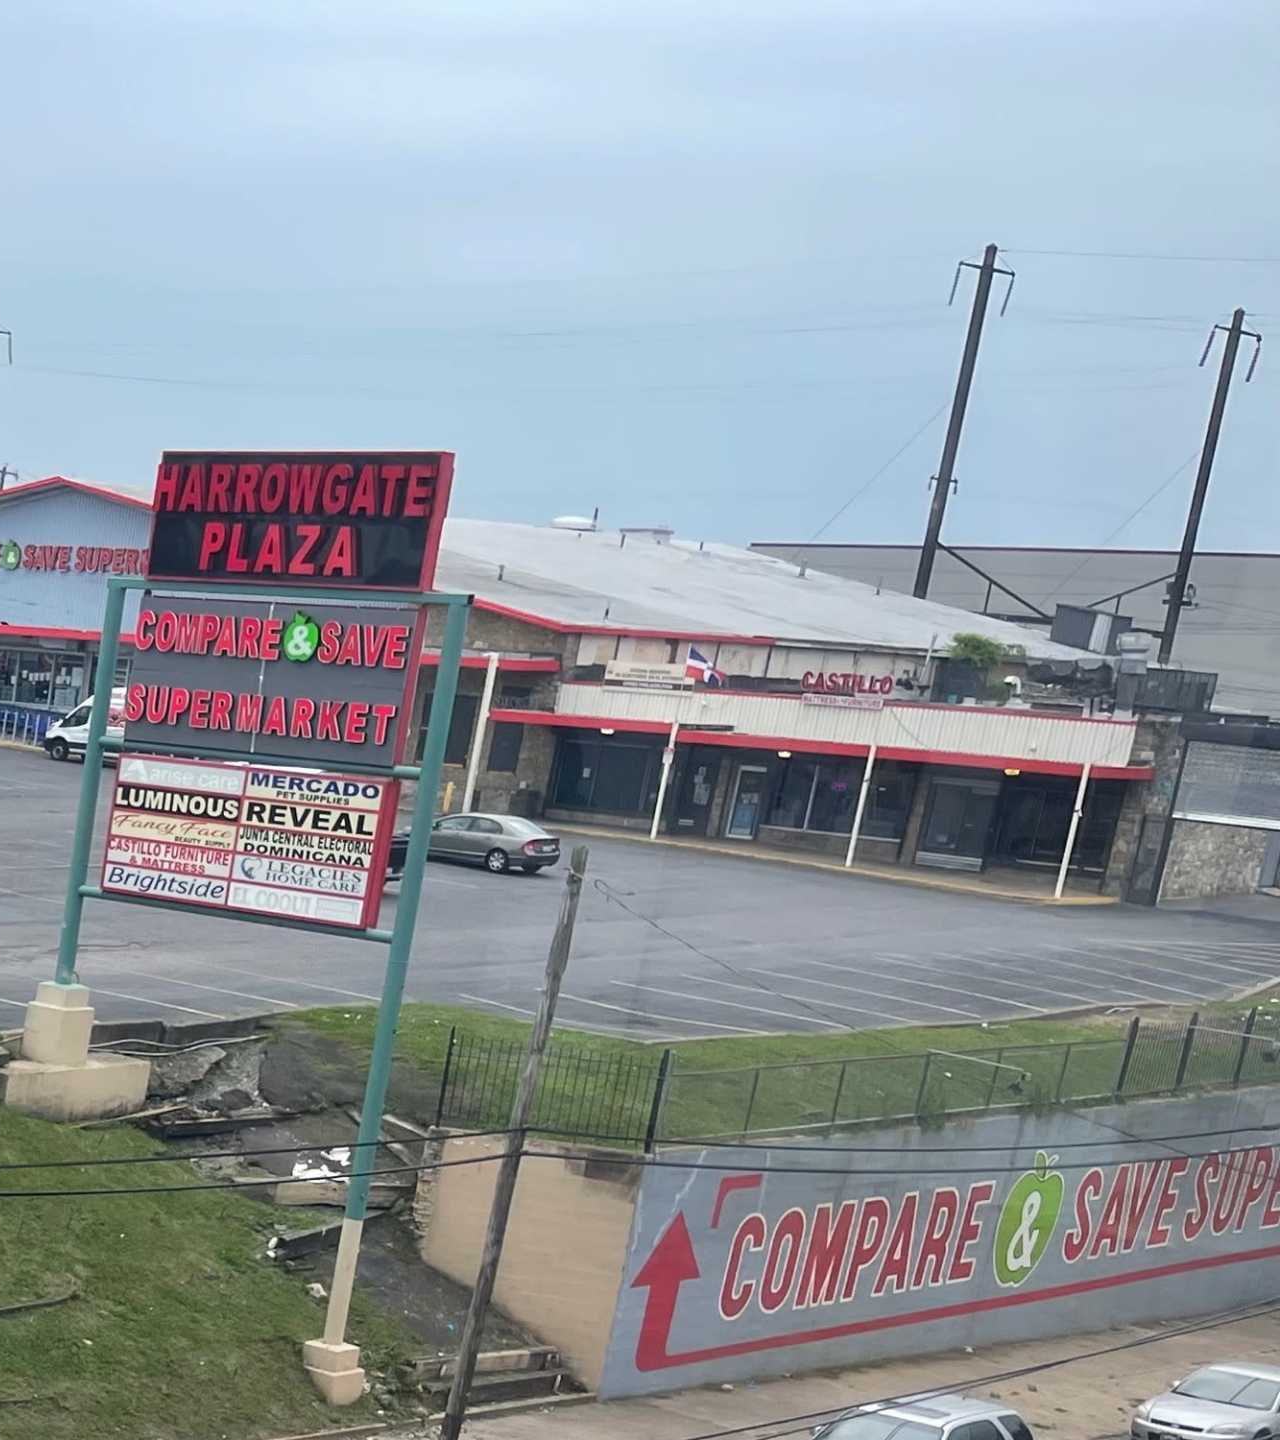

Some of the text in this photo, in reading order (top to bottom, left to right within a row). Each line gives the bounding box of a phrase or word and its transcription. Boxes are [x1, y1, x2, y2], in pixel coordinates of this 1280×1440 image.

[153, 463, 440, 518] HARROWGATE
[23, 544, 71, 573] SAVE
[199, 521, 358, 577] PLAZA
[135, 609, 409, 669] COMPARE & SAVE
[802, 671, 893, 694] CASTILLO
[125, 684, 396, 745] SUPERMARKET
[250, 773, 380, 799] MERCADO
[276, 790, 350, 805] PET SUPPLIES
[115, 786, 239, 819] LUMINOUS
[113, 814, 234, 839] Fancy Face
[246, 801, 373, 836] REVEAL
[109, 838, 230, 867] CASTILLO FURNITURE
[240, 827, 374, 855] JUNTA CENTRAL ELECTORAL
[243, 842, 365, 868] DOMINICANA
[142, 857, 206, 874] MATTRESS
[268, 860, 362, 883] LEGACIES
[107, 866, 225, 899] Brightside
[265, 872, 360, 893] HOME CARE
[718, 1180, 995, 1321] COMPARE
[1005, 1190, 1045, 1273] &
[1062, 1156, 1191, 1264] SAVE
